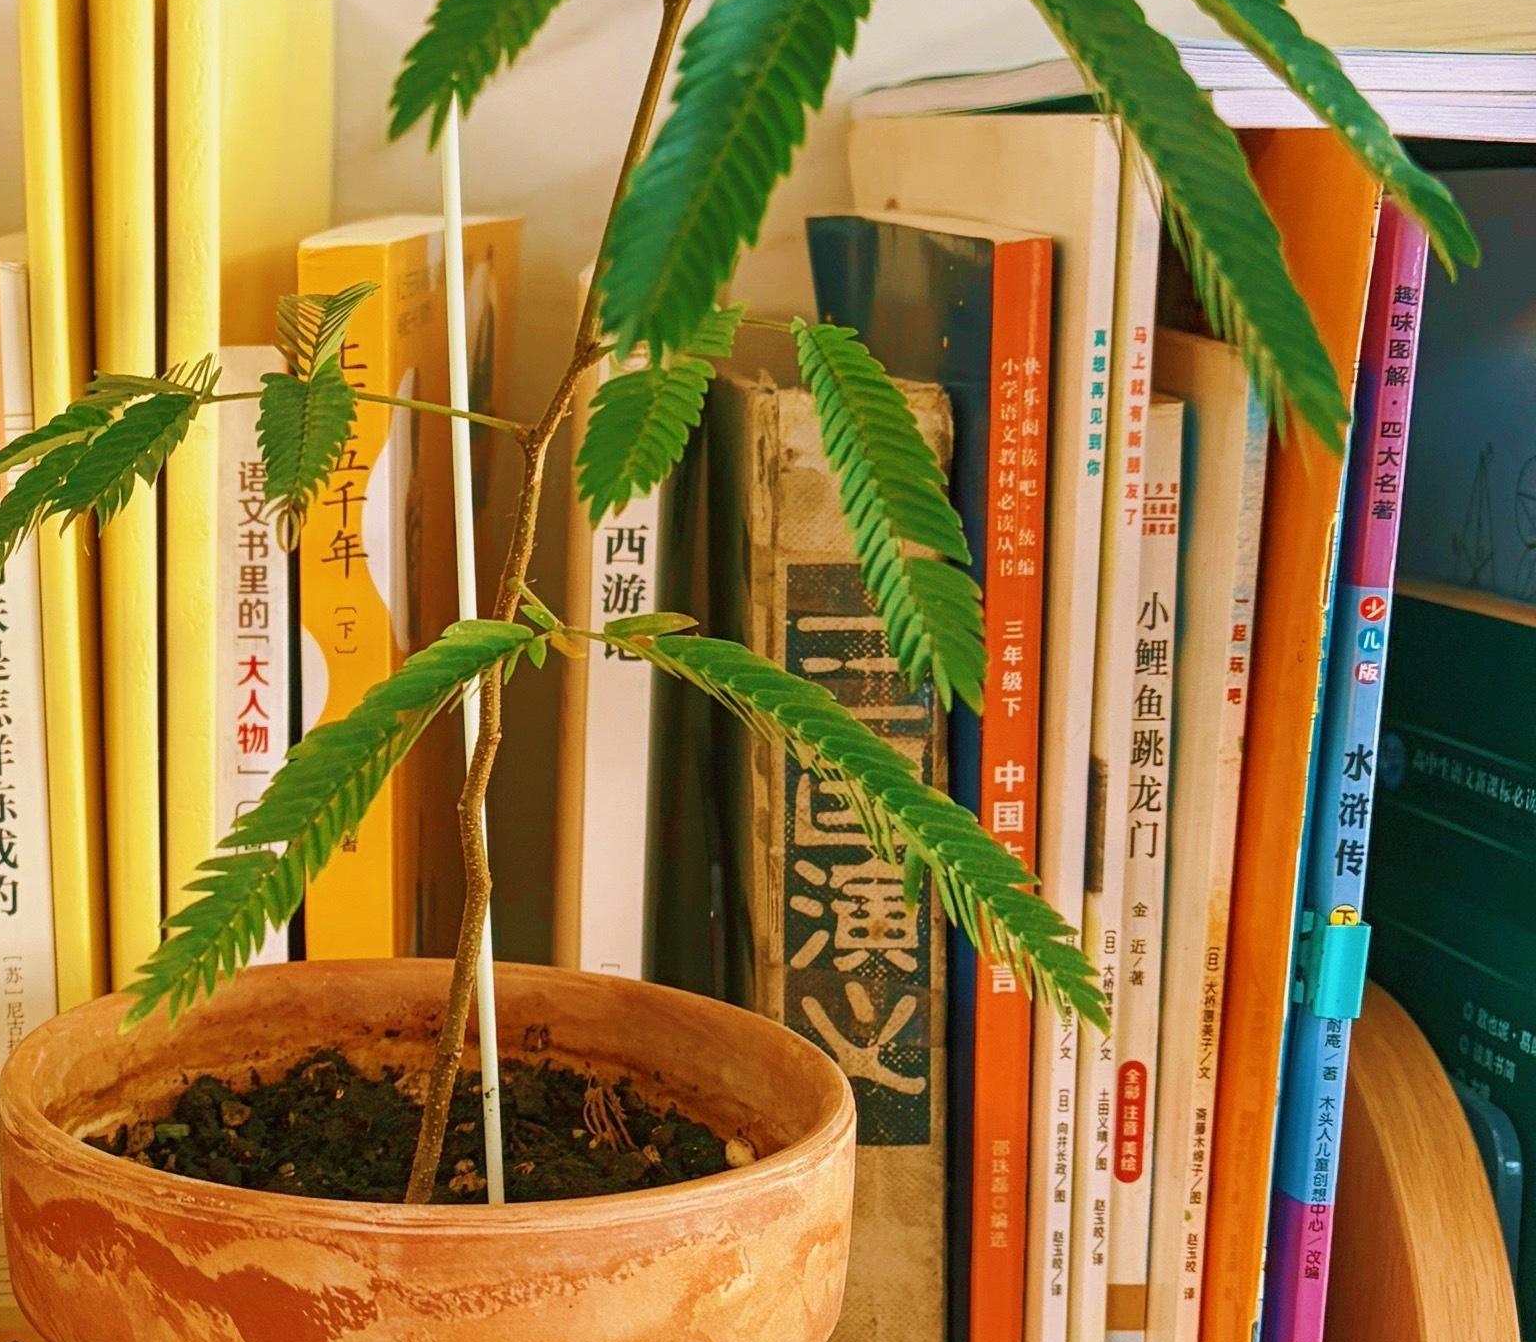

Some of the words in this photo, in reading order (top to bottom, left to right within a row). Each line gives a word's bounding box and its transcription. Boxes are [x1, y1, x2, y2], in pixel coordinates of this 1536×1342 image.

[322, 342, 370, 580] 上五千年
[1086, 329, 1107, 478] 真想再见到你
[1123, 325, 1148, 527] 马上就有新朋友了
[1371, 284, 1418, 521] 趣味图解·四大名著
[1000, 618, 1024, 718] 三年级下
[1128, 591, 1170, 860] 小鲤鱼跳龙门
[1226, 596, 1249, 705] 一起玩吧
[1357, 595, 1386, 683] 少儿版
[990, 759, 1025, 994] 中国言
[1335, 744, 1373, 877] 水浒传
